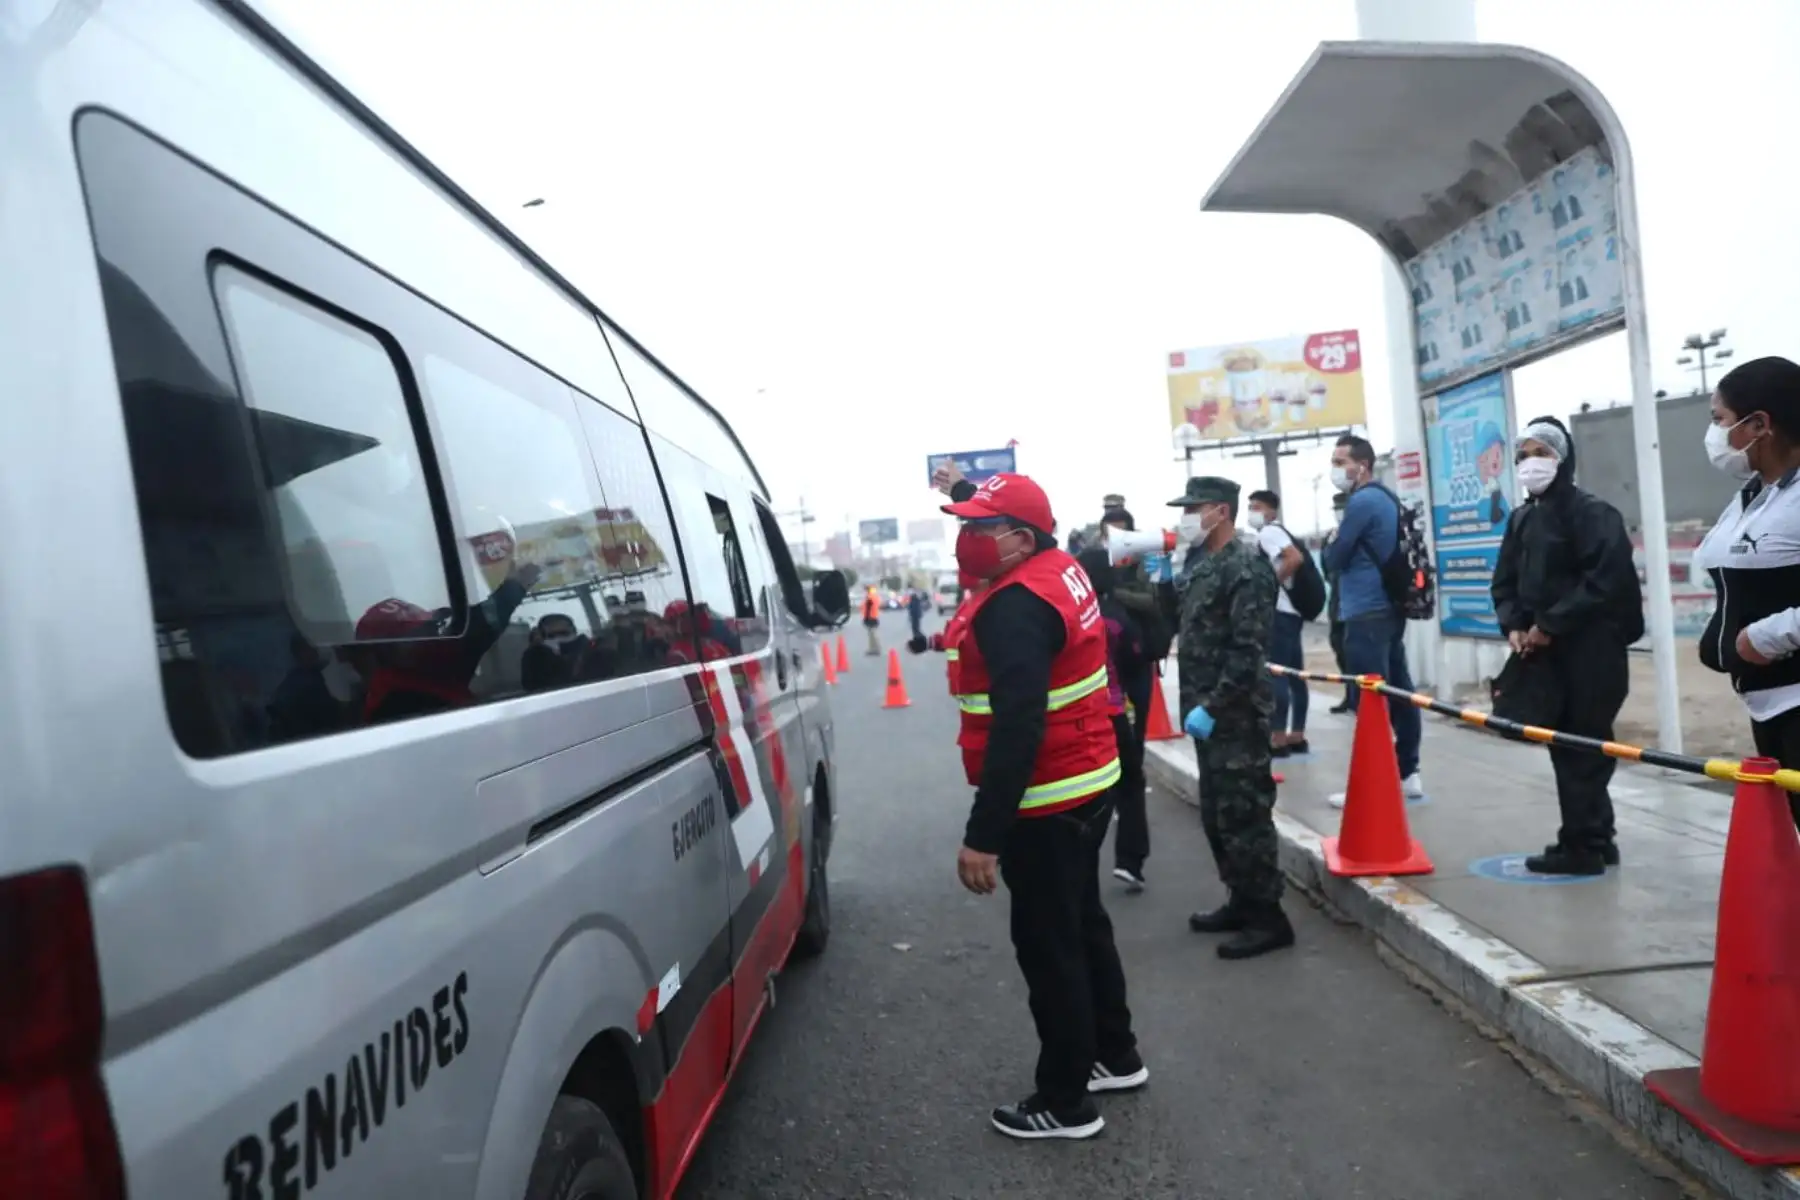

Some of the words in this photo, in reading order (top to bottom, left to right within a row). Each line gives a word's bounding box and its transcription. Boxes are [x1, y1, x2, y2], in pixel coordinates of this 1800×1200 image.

[1320, 344, 1346, 369] 29
[671, 793, 716, 862] EJERCITO
[223, 970, 470, 1200] BENAVIDES
